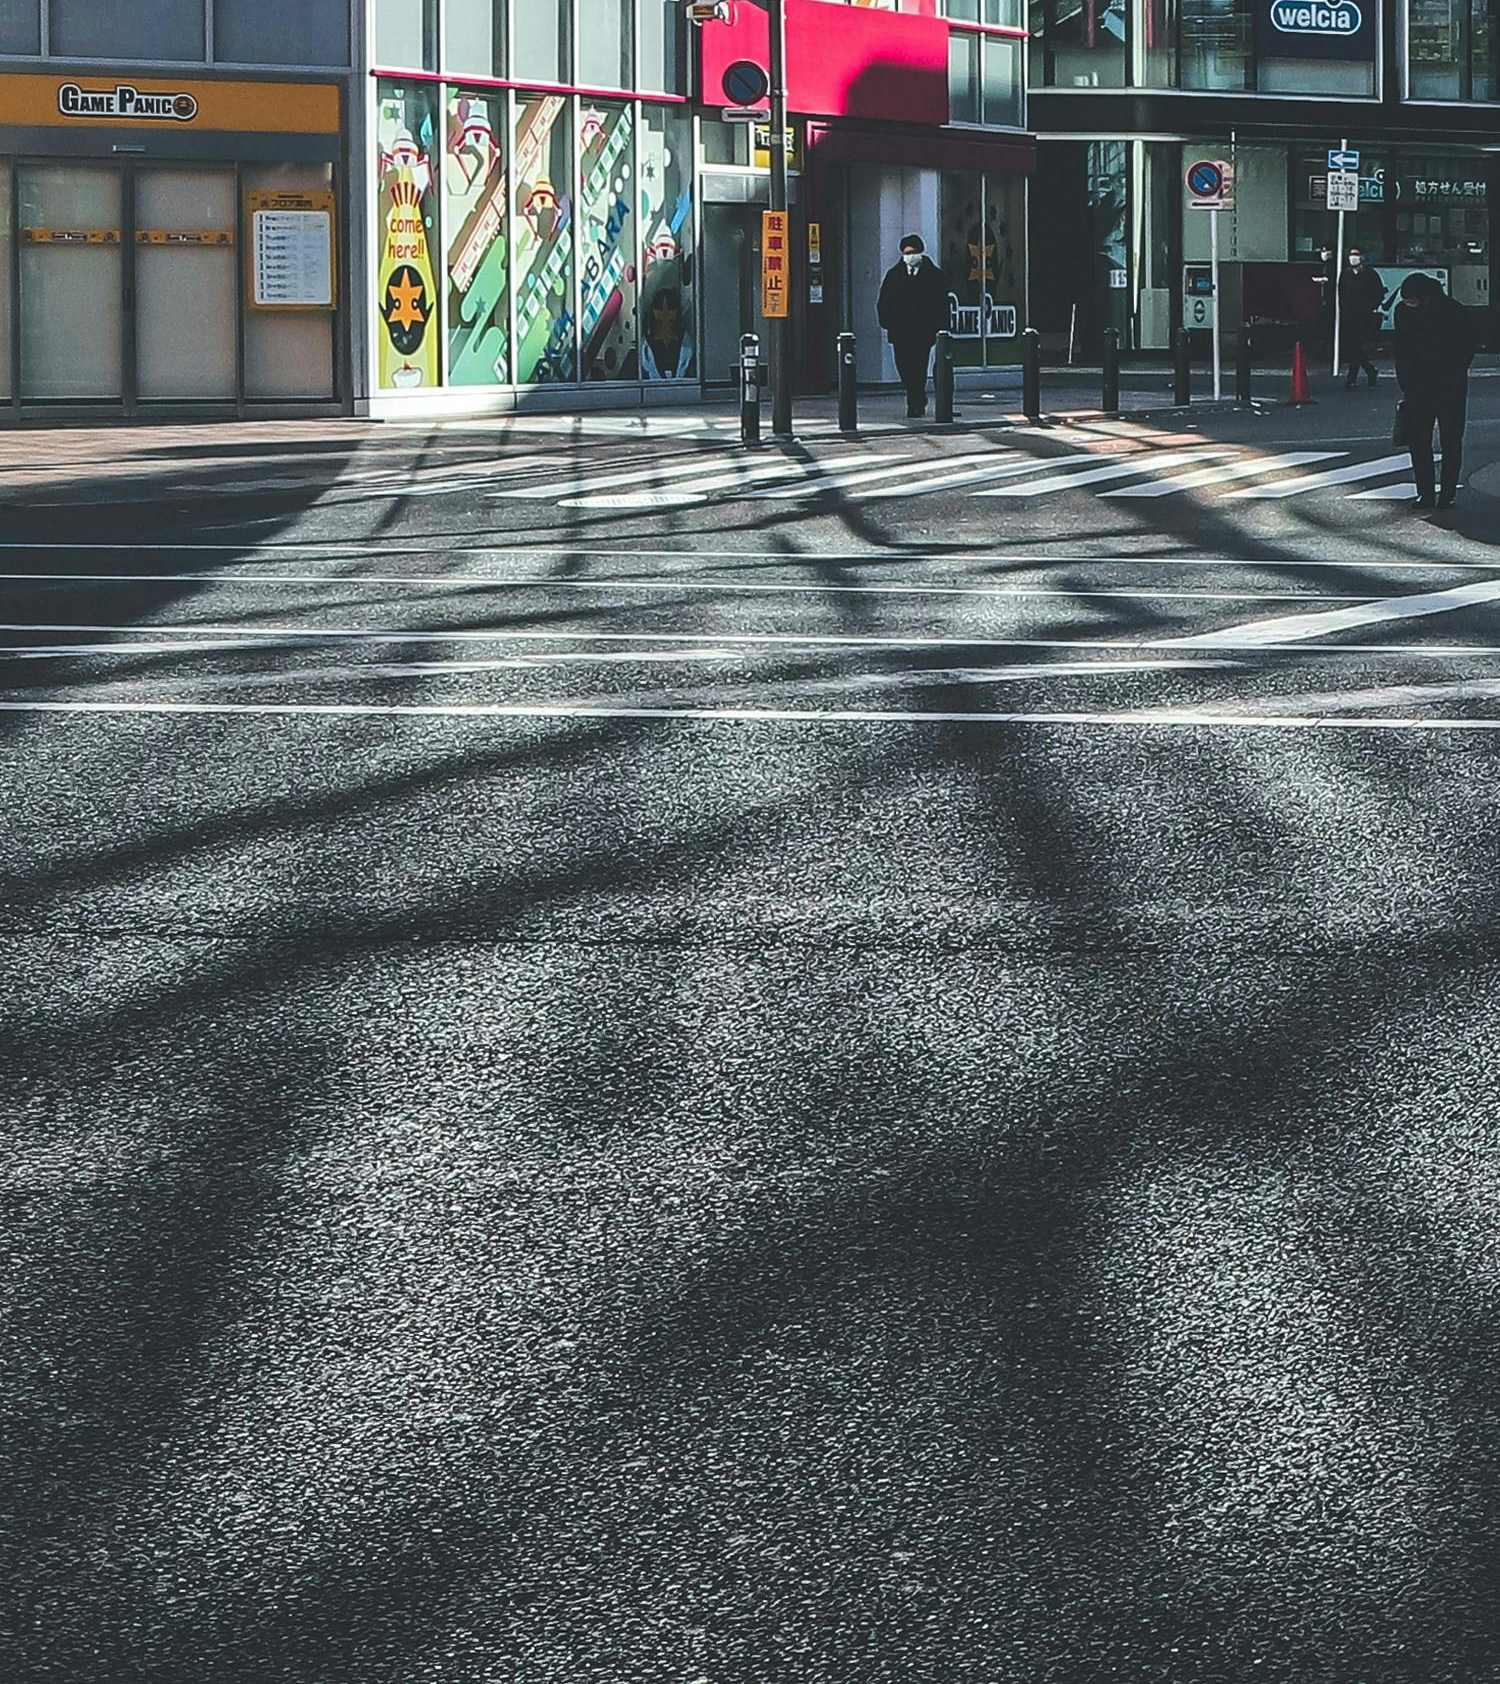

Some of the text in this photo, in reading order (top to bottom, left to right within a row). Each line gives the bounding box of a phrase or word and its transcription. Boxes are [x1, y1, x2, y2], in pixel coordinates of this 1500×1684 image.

[1414, 181, 1487, 197] 処方せん受付
[389, 217, 424, 233] come
[388, 237, 425, 260] here!!
